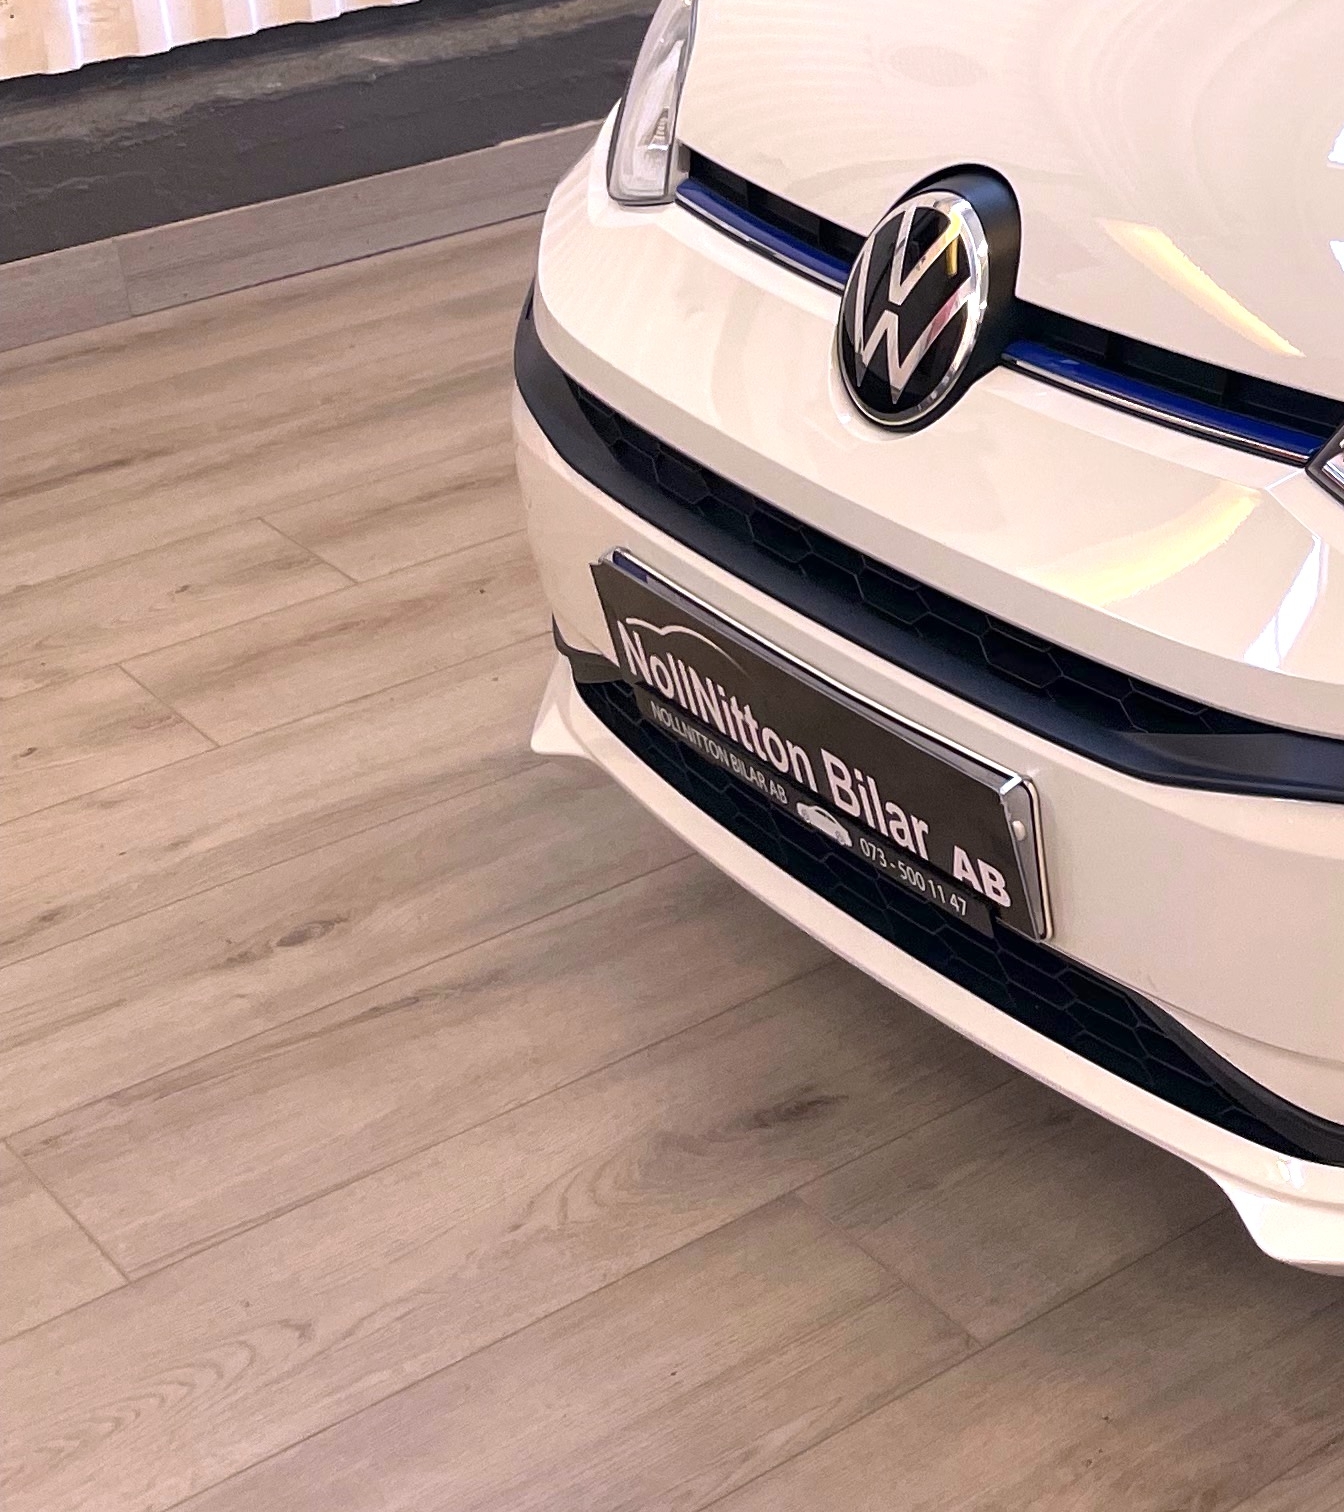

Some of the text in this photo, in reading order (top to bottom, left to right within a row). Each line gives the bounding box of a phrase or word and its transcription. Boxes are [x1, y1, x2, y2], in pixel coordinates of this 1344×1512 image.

[617, 620, 1012, 908] NollNitton Bilar AB
[650, 700, 788, 805] NOLLNITTON BILAR AB
[928, 879, 946, 904] 11
[949, 893, 967, 916] 47
